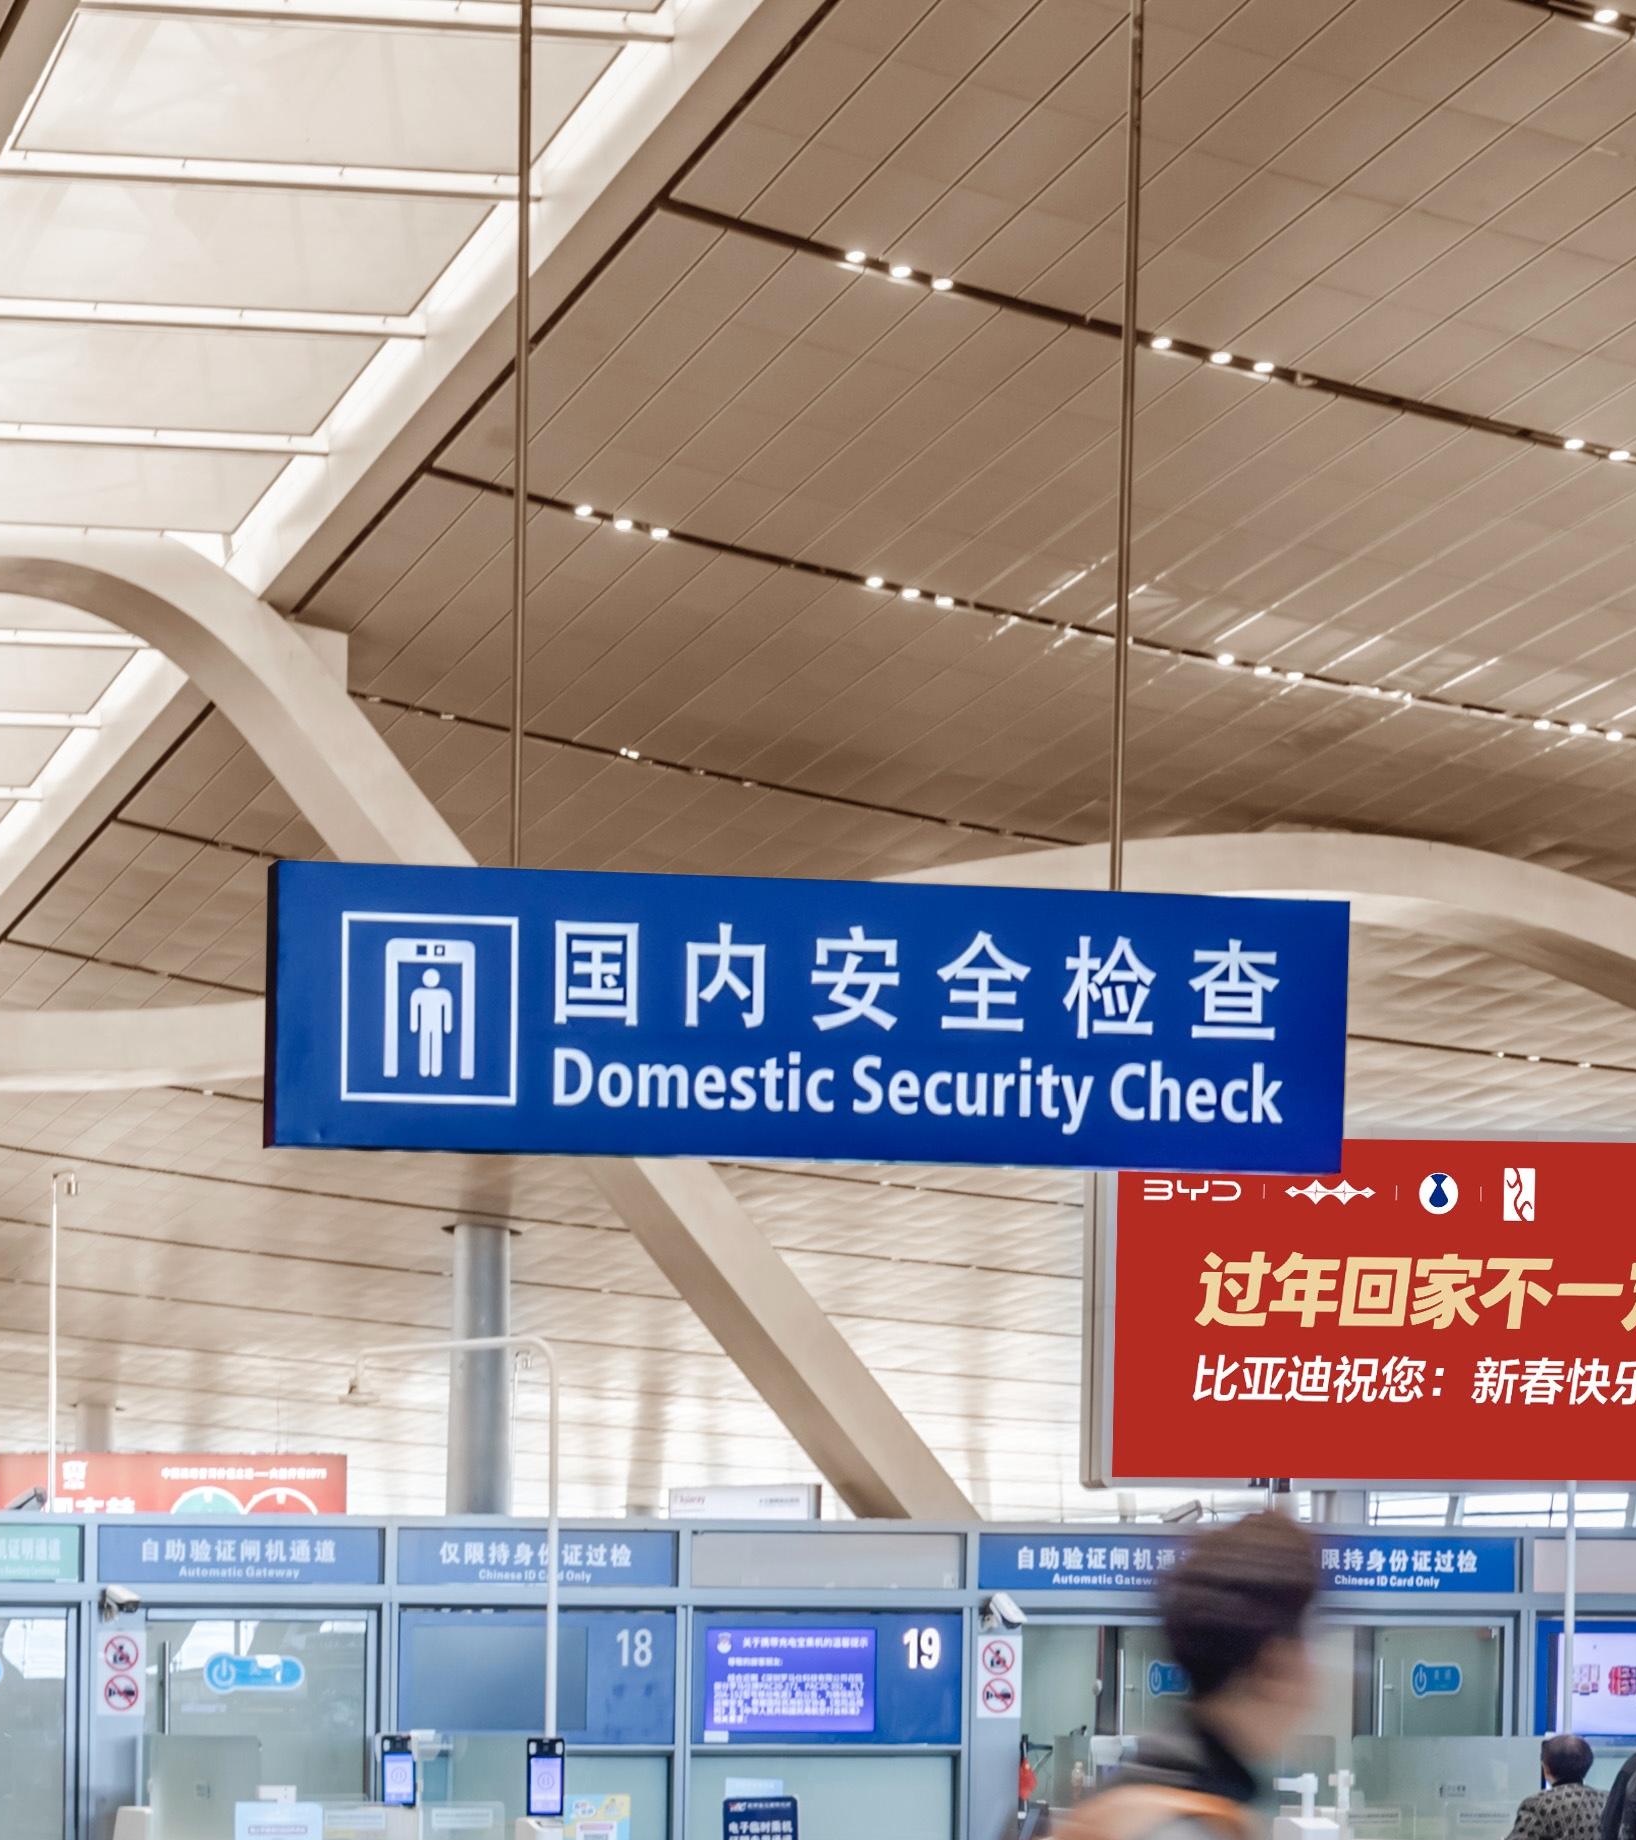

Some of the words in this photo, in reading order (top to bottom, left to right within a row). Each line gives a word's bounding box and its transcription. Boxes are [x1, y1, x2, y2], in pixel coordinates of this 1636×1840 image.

[552, 920, 1281, 1042] 国内安全检查
[552, 1046, 835, 1114] Domestic
[852, 1055, 1093, 1136] Security
[1110, 1060, 1284, 1125] Check
[1143, 1178, 1242, 1202] BYD
[141, 1538, 336, 1563] 自助验证闸机通道
[439, 1542, 632, 1566] 仅限持身份证过检
[1017, 1546, 1188, 1570] 自助验证闸机通
[179, 1566, 242, 1579] Automatic
[246, 1566, 300, 1581] Gateway
[478, 1569, 521, 1582] Chinese
[524, 1570, 537, 1582] ID
[566, 1570, 592, 1585] Only
[1052, 1573, 1112, 1585] Automatic
[1334, 1575, 1374, 1586] Chinese
[1376, 1575, 1387, 1587] ID
[1390, 1575, 1414, 1588] Card
[1415, 1575, 1440, 1590] Only
[616, 1628, 654, 1668] 18
[902, 1627, 943, 1671] 19
